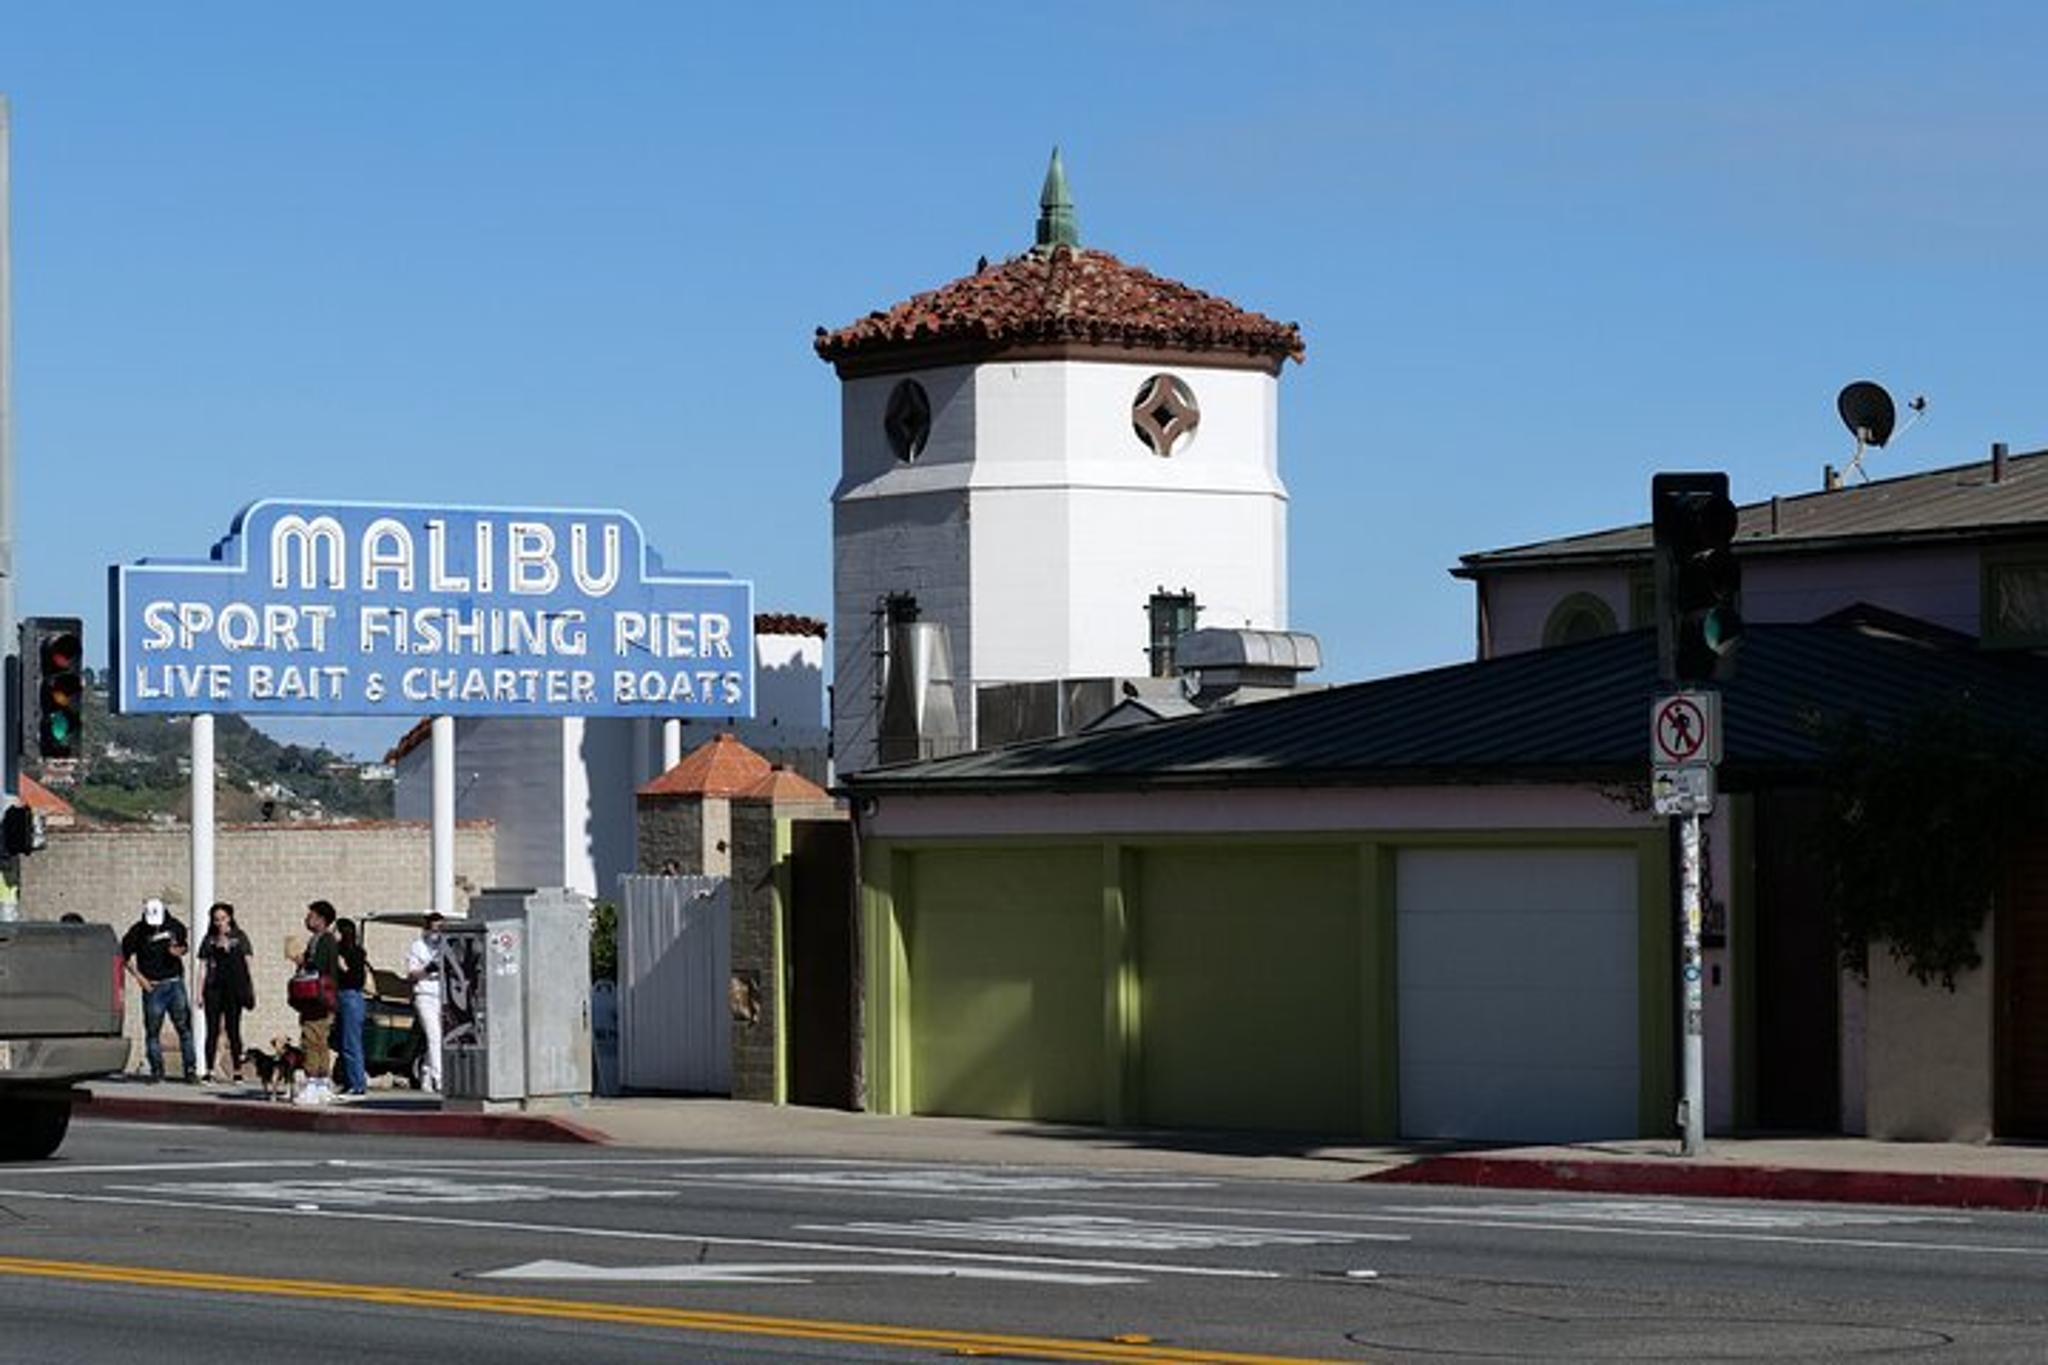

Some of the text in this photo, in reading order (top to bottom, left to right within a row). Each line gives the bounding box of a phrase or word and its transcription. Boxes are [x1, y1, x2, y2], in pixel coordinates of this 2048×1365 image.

[271, 514, 620, 596] MALIBU
[142, 601, 733, 658] SPORT FISHING PIER
[136, 664, 742, 705] LIVE BAIT & CHARTER BOATS
